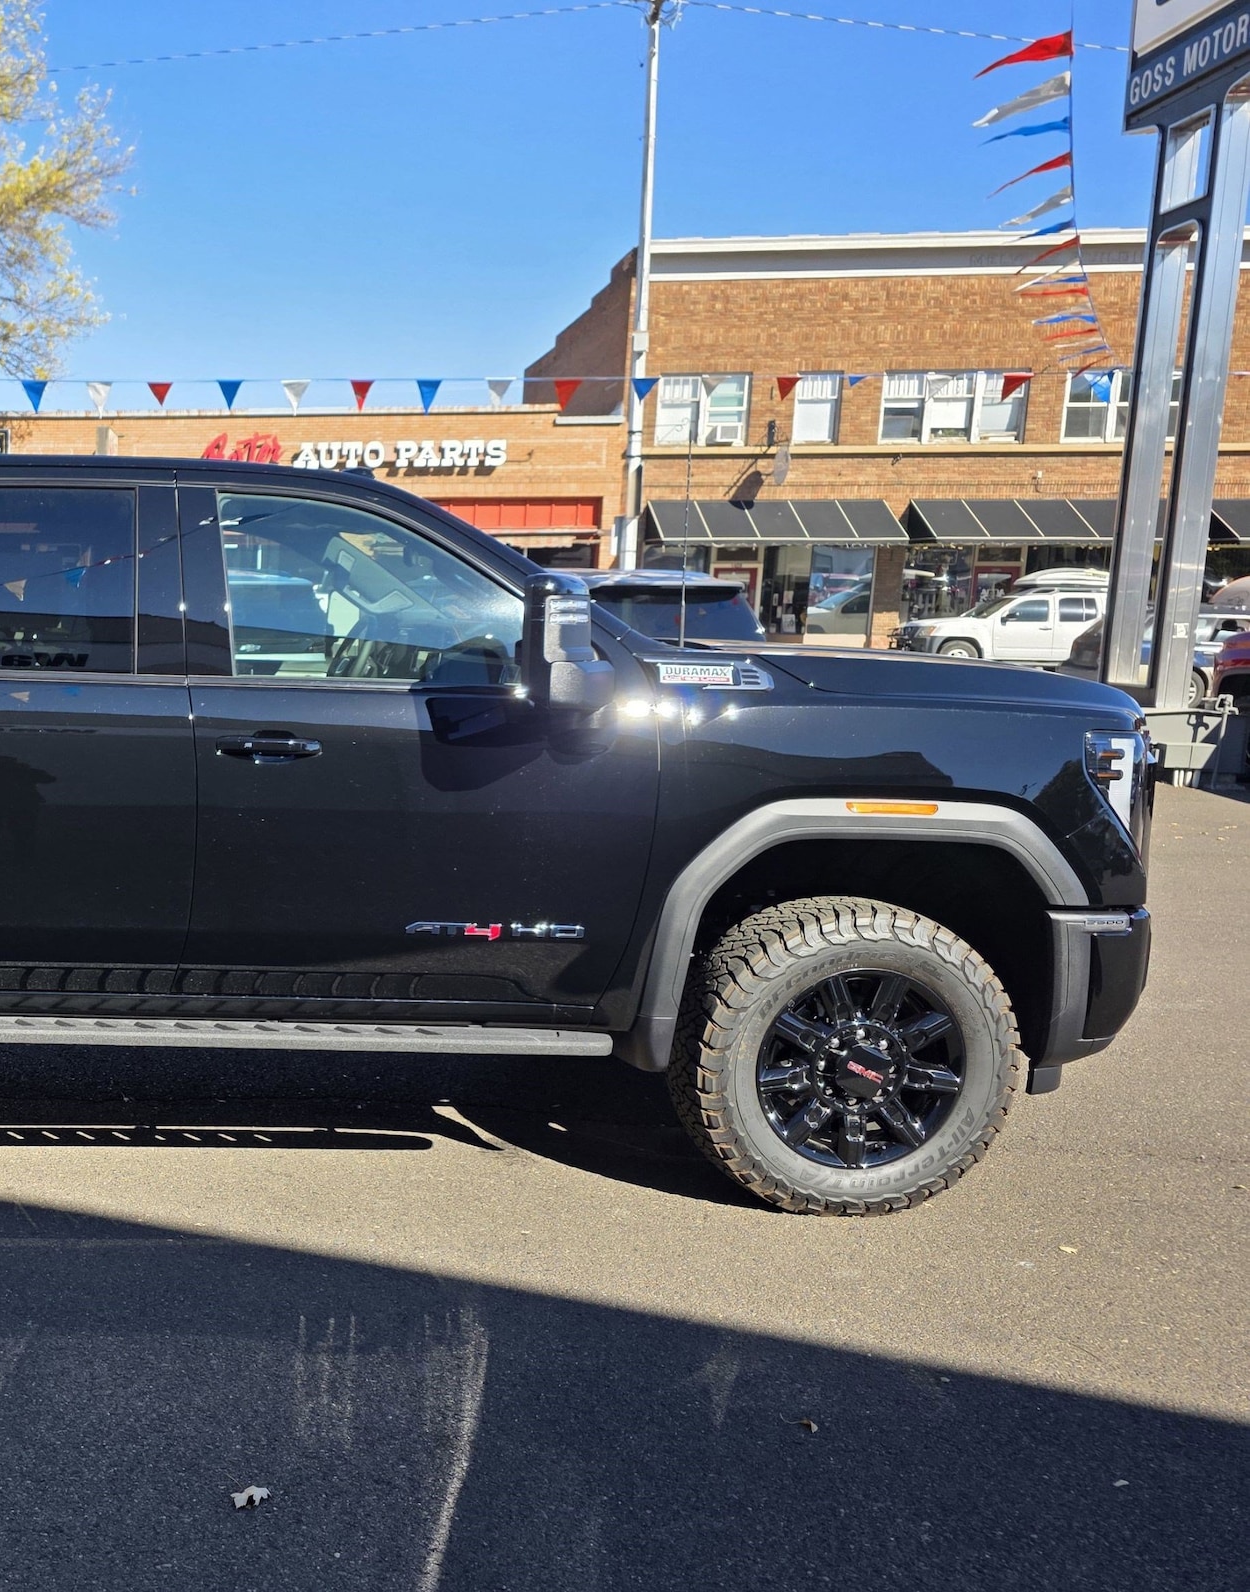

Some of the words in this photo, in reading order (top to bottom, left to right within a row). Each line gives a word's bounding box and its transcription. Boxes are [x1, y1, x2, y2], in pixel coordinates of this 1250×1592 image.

[1131, 56, 1175, 105] GOSS
[293, 441, 385, 469] AUTO
[395, 439, 508, 468] PARTS
[665, 666, 728, 677] DURAMAX
[405, 921, 502, 941] AT4
[510, 921, 585, 938] HD
[846, 1060, 884, 1085] GMC
[850, 1106, 975, 1191] All-Terrain
